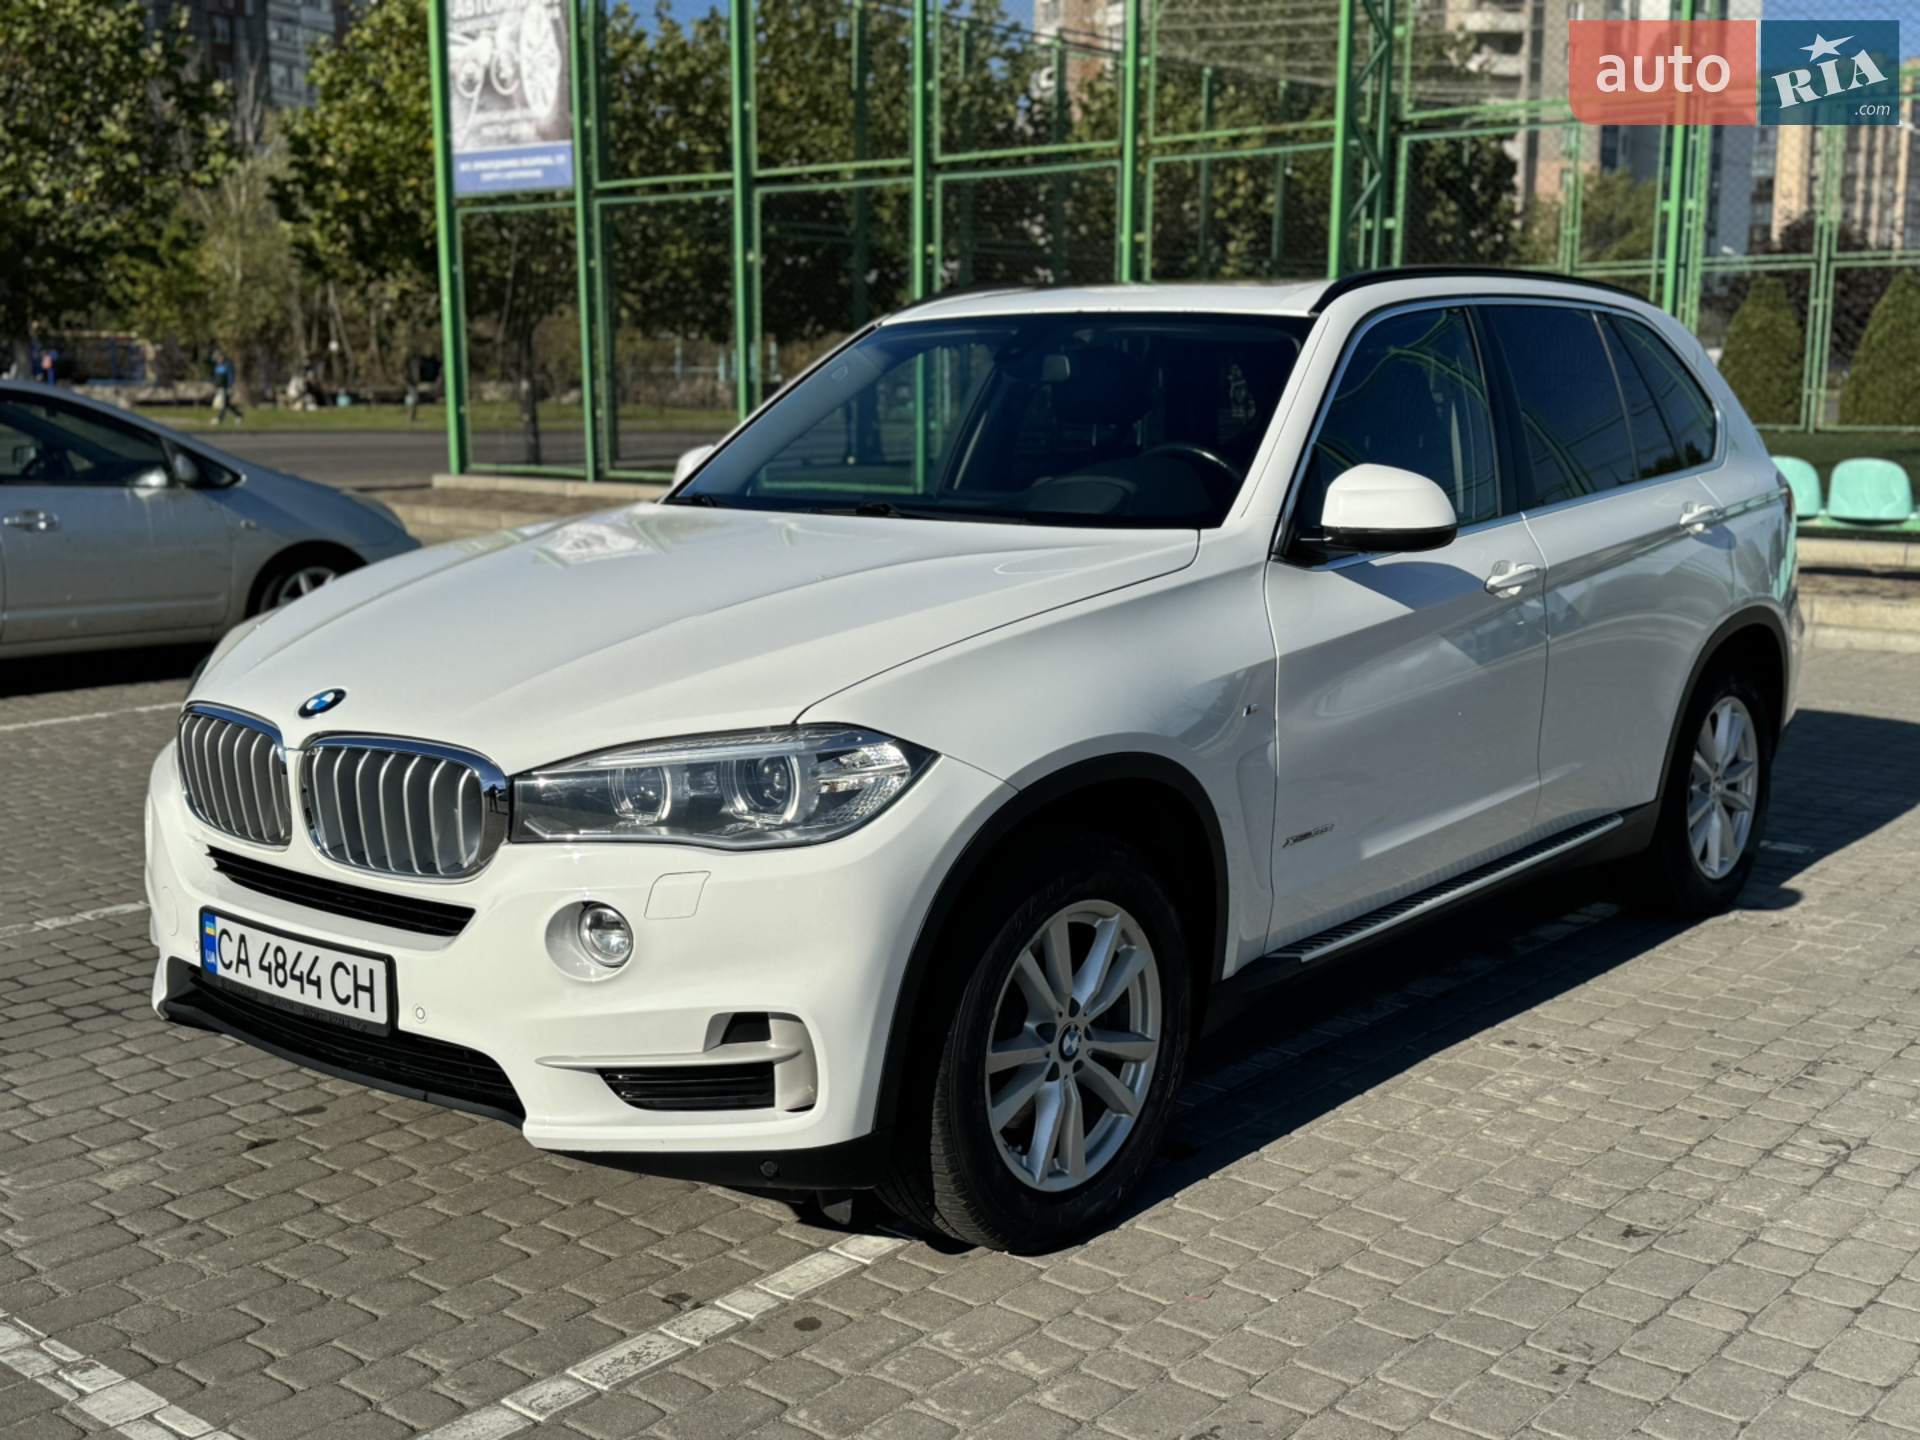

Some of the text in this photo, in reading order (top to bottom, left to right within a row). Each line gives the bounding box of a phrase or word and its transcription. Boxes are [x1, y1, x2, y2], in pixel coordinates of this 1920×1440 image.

[206, 949, 217, 964] UA
[218, 928, 251, 978] CA
[258, 942, 321, 999] 4844
[330, 961, 375, 1013] CH
